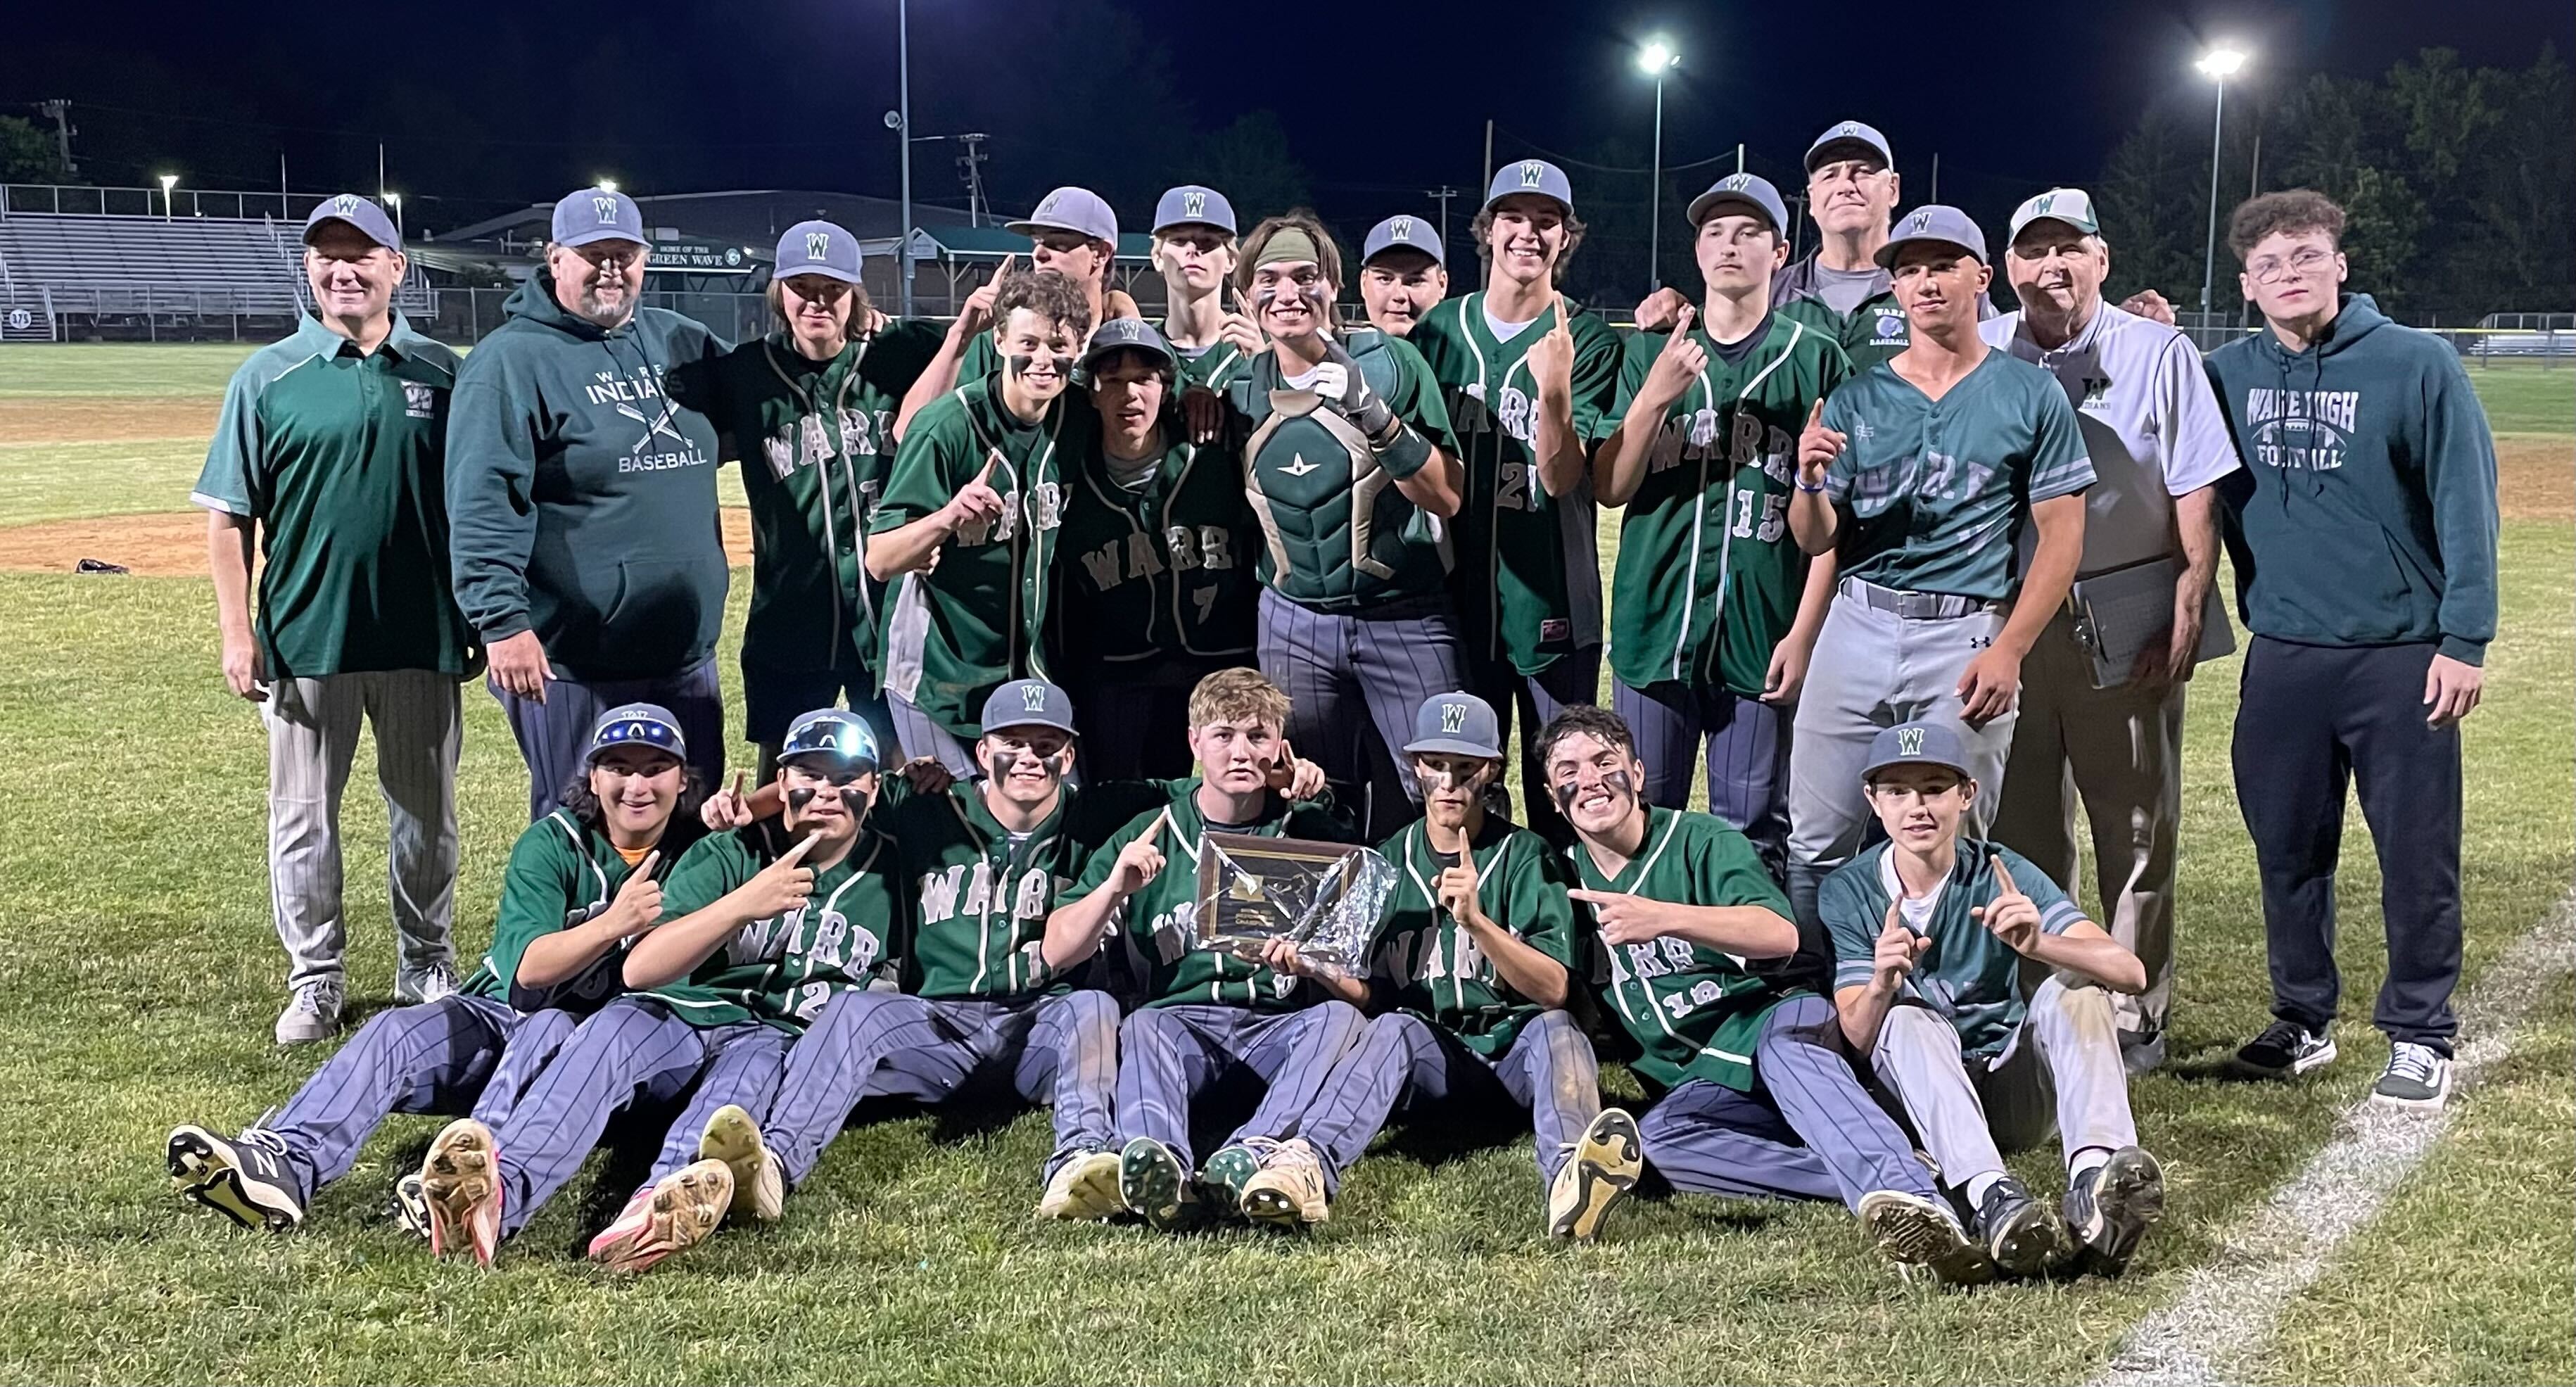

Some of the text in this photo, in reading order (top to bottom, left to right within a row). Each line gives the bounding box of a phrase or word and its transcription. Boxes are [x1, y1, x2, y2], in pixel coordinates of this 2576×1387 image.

[1520, 163, 1544, 188] W
[1726, 175, 1751, 193] W
[334, 196, 360, 217] W
[592, 197, 617, 224] W
[1184, 191, 1206, 217] W
[2033, 194, 2058, 215] W
[1390, 219, 1413, 241] W
[1910, 211, 1933, 236] W
[806, 232, 830, 260] W
[647, 253, 687, 265] GREEN
[691, 255, 723, 267] WAVE
[1119, 320, 1139, 341] W
[618, 448, 708, 473] BASEBALL
[1651, 409, 1794, 488] WARE
[1732, 489, 1785, 543] 15
[1081, 524, 1233, 592] WARE
[1193, 582, 1219, 619] 7
[1020, 685, 1046, 712] W
[1442, 703, 1466, 733] W
[1898, 728, 1924, 756] W
